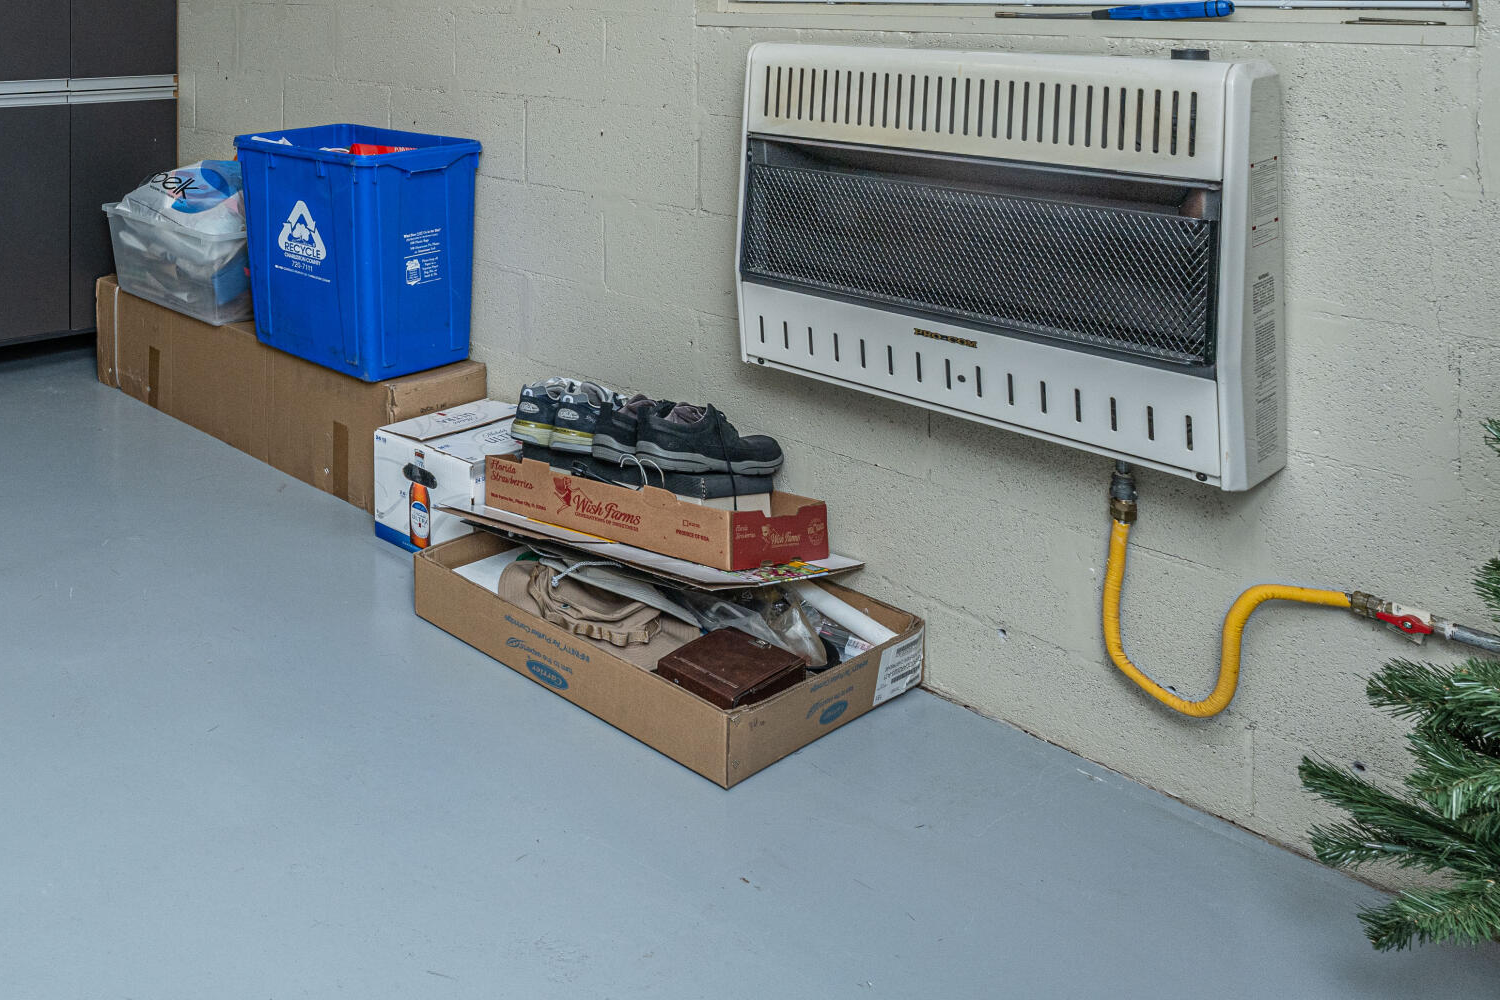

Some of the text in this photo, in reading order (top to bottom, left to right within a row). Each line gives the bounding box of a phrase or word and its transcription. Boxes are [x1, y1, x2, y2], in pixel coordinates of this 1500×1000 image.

[284, 241, 321, 259] RECYCLE
[490, 459, 516, 474] Florida
[490, 470, 534, 490] Strawberries
[573, 495, 641, 526] Wish Farms
[532, 665, 562, 685] Carrier
